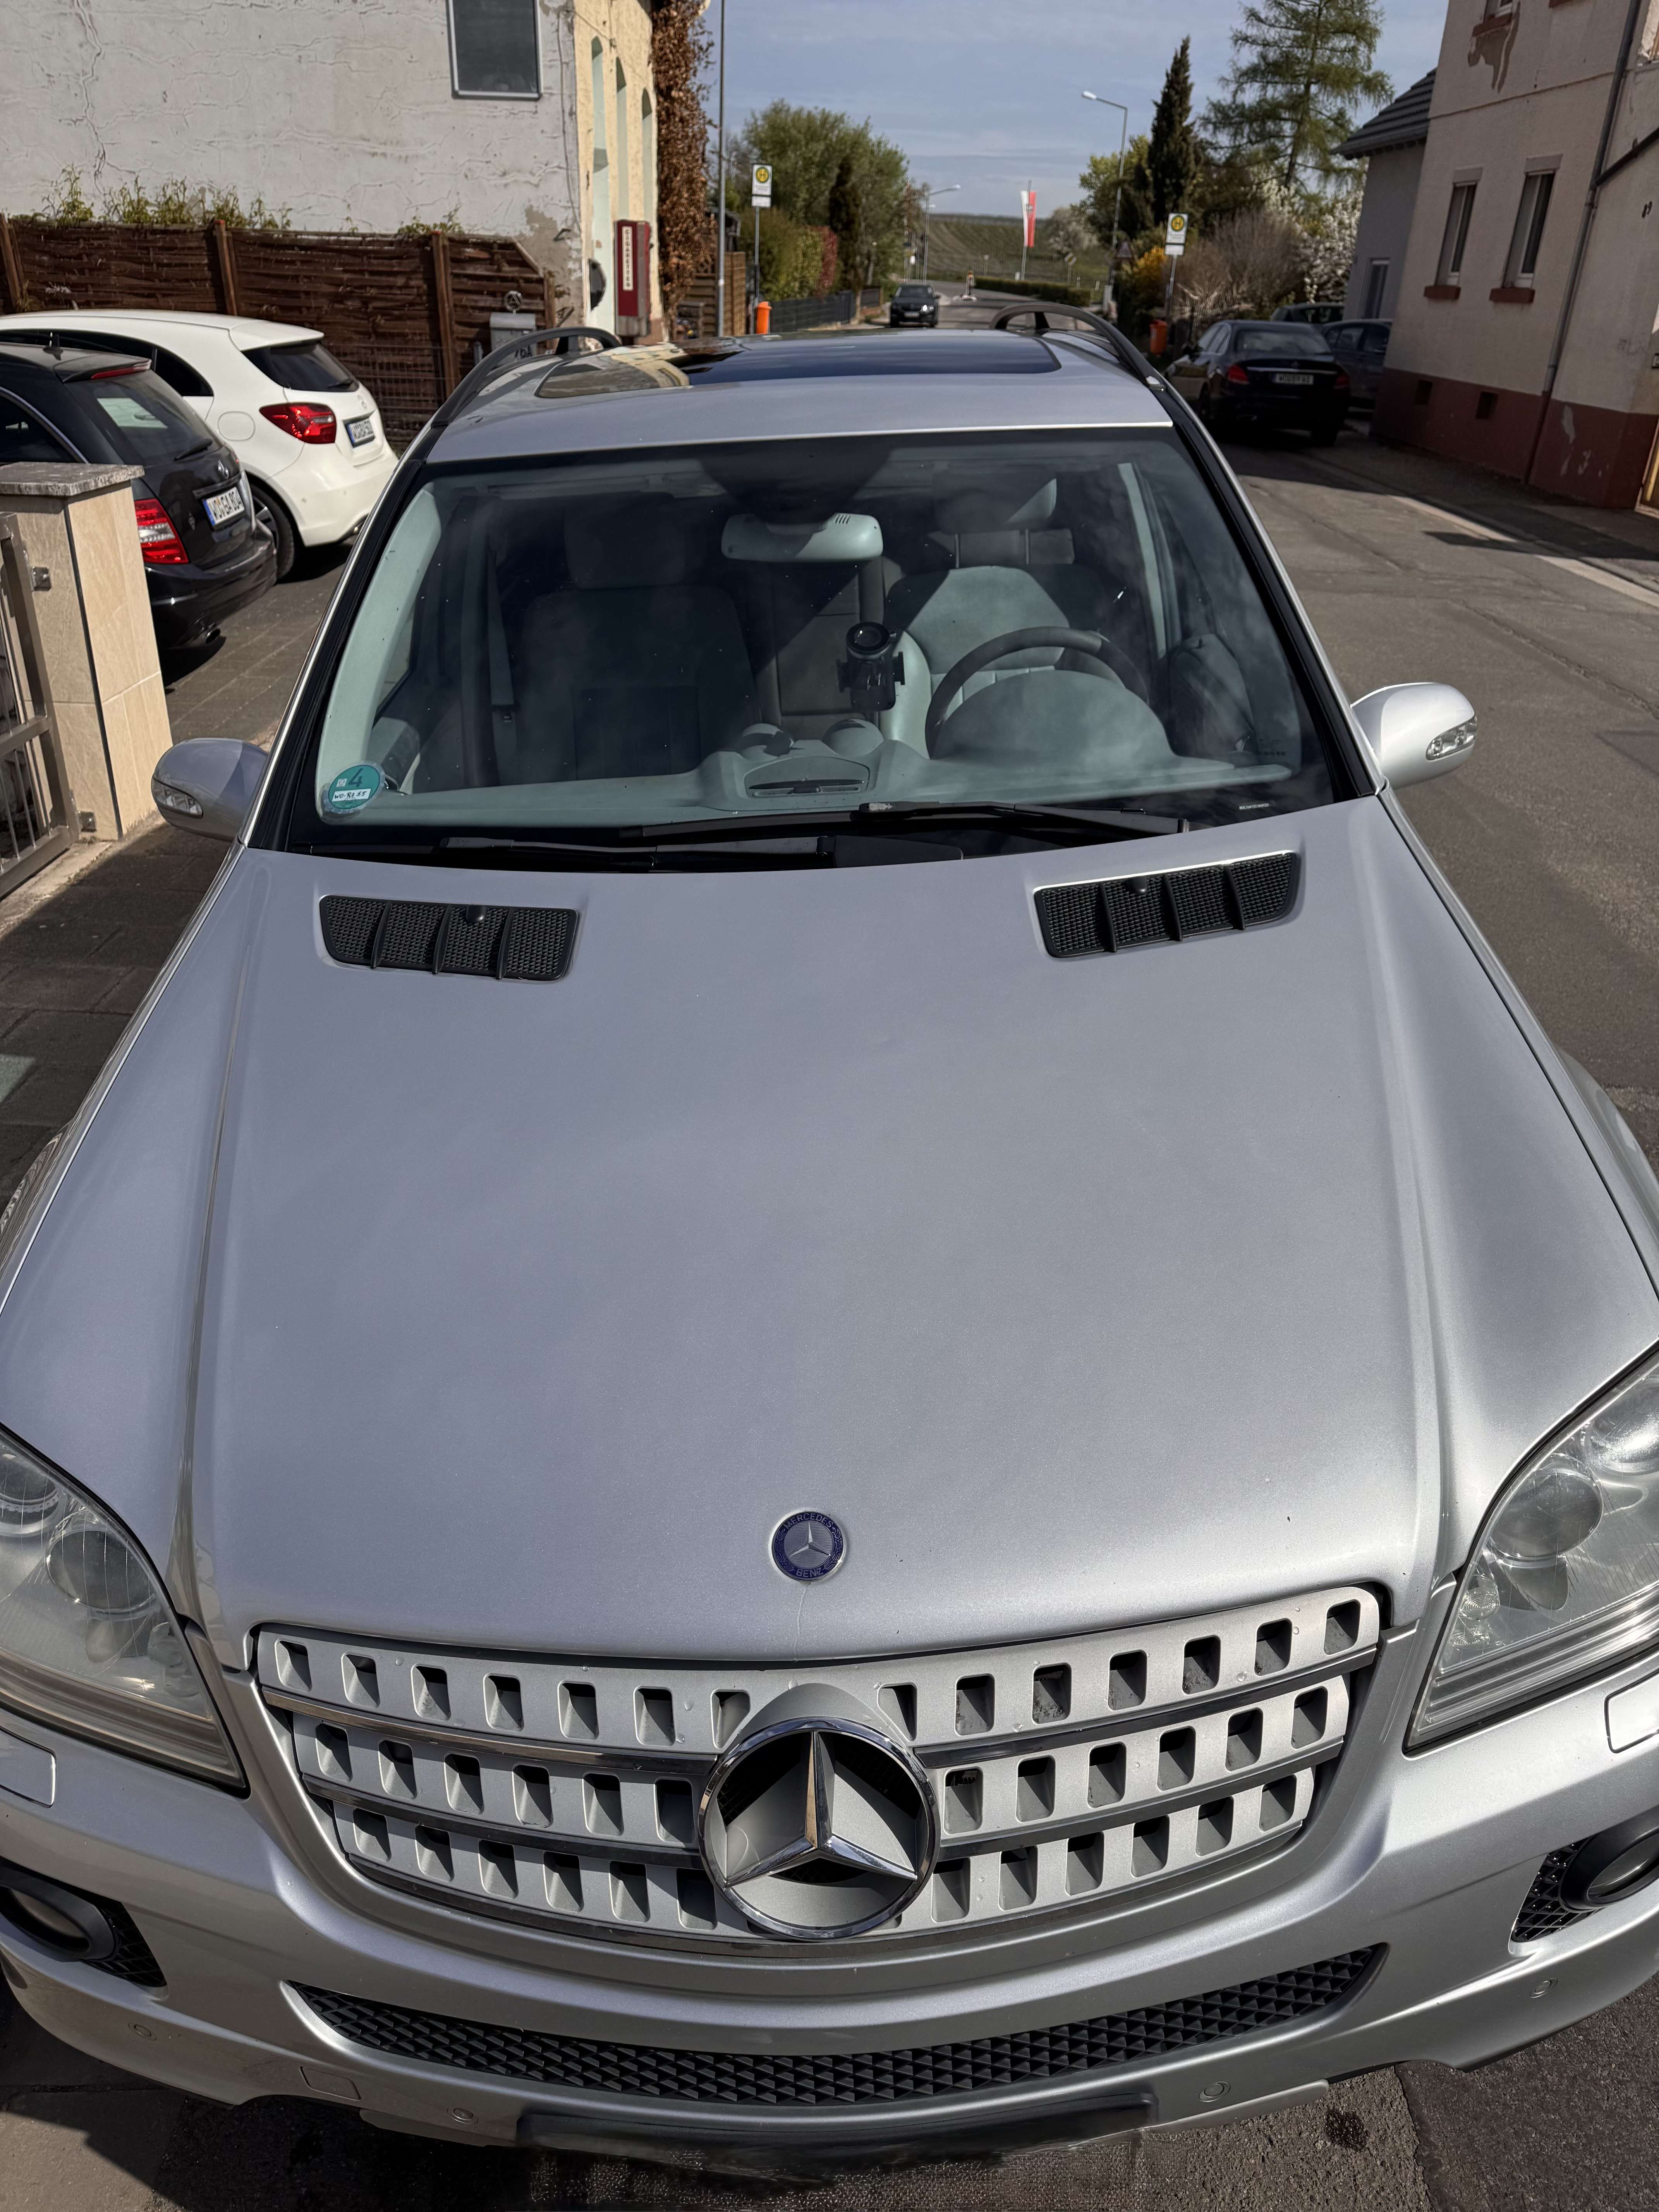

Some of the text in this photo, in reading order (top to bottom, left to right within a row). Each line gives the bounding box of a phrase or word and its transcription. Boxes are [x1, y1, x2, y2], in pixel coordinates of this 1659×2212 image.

[348, 768, 363, 787] 4
[784, 1513, 833, 1529] MERCEDES
[796, 1567, 824, 1578] BENZ
